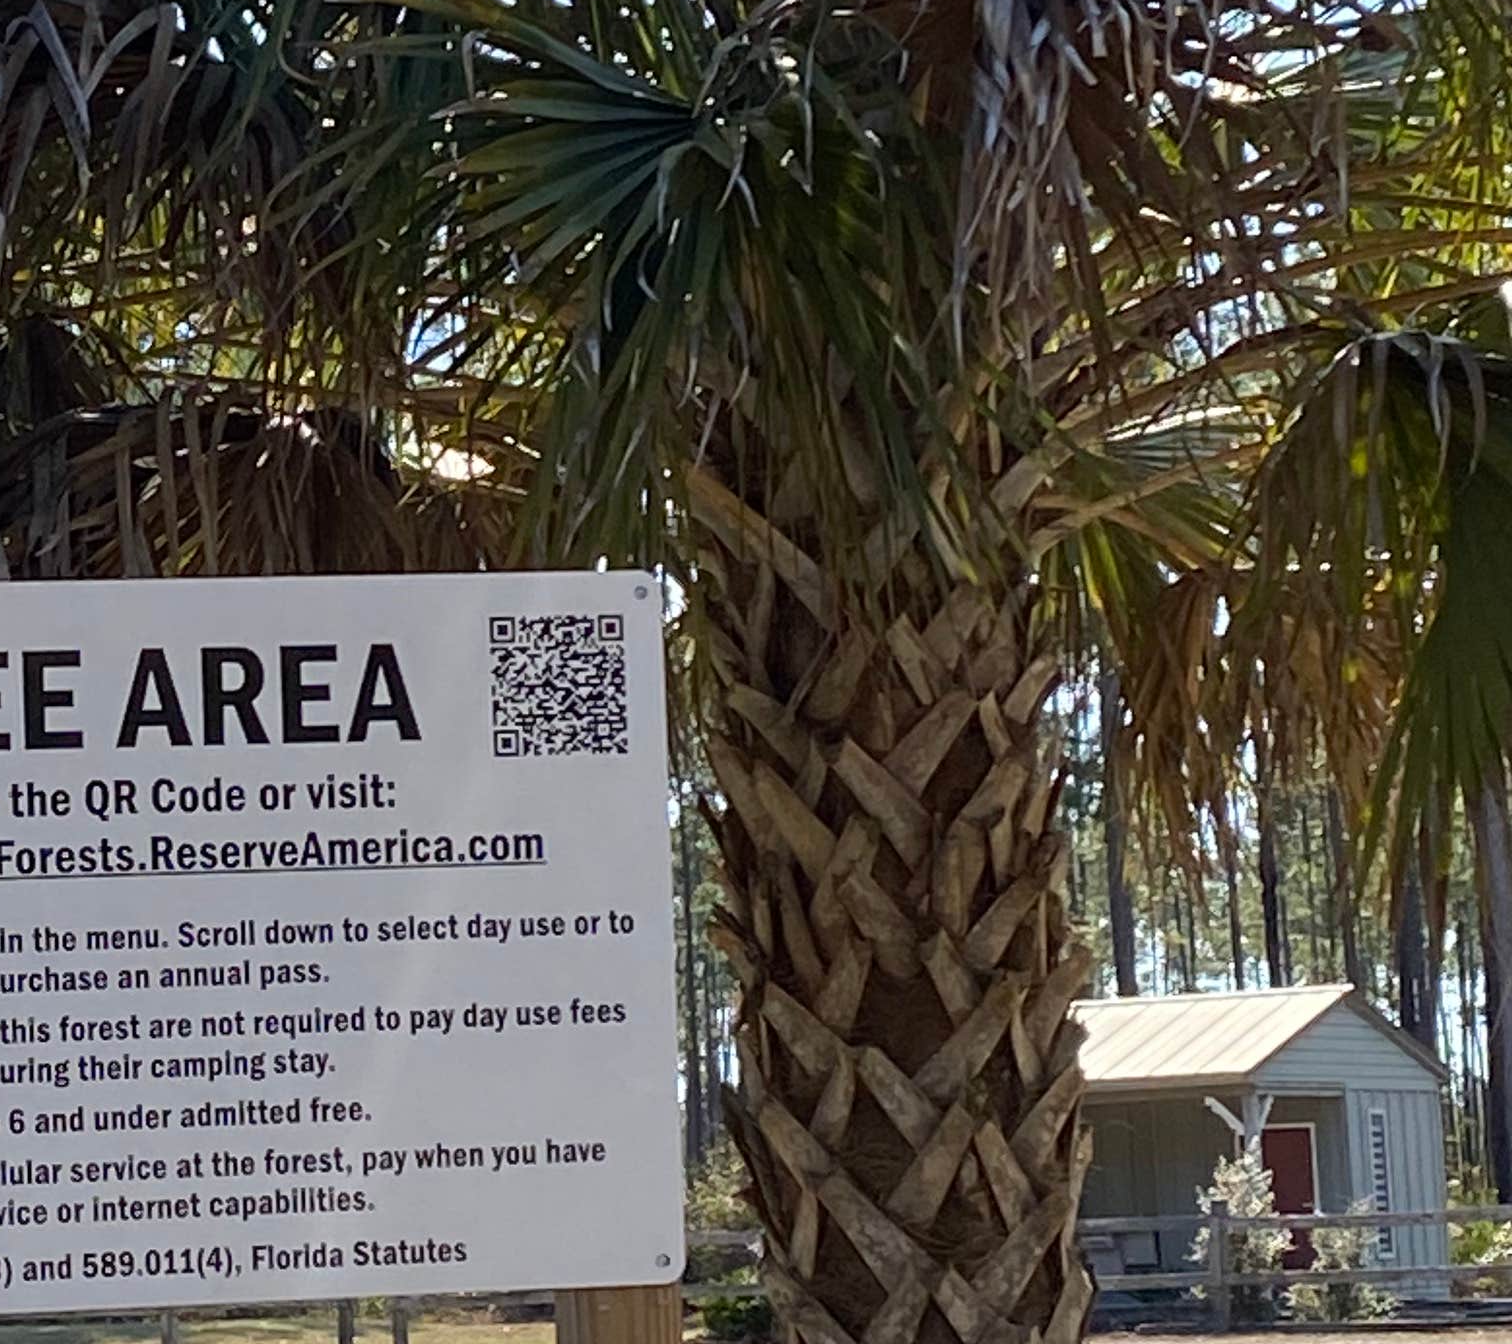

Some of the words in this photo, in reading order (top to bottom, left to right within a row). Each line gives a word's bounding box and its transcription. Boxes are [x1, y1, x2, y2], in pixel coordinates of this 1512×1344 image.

[115, 643, 423, 749] AREA
[8, 781, 72, 818] the
[84, 779, 139, 822] QR
[151, 776, 246, 814] Code
[259, 783, 297, 811] or
[306, 773, 396, 810] visit:
[0, 927, 23, 954] in
[31, 925, 77, 954] the
[85, 928, 169, 951] menu.
[177, 919, 256, 948] Scroll
[264, 918, 334, 945] down
[342, 917, 369, 943] to
[377, 914, 460, 942] select
[466, 913, 512, 944] day
[519, 916, 566, 937] use
[574, 915, 601, 936] or
[608, 909, 634, 935] to
[117, 969, 151, 990] an
[159, 959, 250, 989] annual
[259, 963, 330, 991] pass.
[58, 1014, 141, 1043] forest
[148, 1017, 192, 1040] are
[201, 1010, 246, 1038] not
[253, 1005, 366, 1041] required
[373, 1005, 401, 1032] to
[409, 1008, 456, 1036] pay
[462, 1002, 508, 1033] day
[516, 1005, 561, 1026] use
[569, 997, 627, 1025] fees
[77, 1053, 143, 1082] their
[150, 1049, 267, 1083] camping
[273, 1048, 336, 1079] stay.
[8, 1108, 26, 1135] 6
[34, 1105, 85, 1135] and
[93, 1103, 173, 1132] under
[180, 1097, 301, 1129] admitted
[309, 1096, 372, 1123] free.
[69, 1154, 167, 1183] service
[176, 1152, 205, 1179] at
[211, 1150, 256, 1178] the
[263, 1146, 353, 1176] forest,
[362, 1150, 407, 1177] pay
[414, 1142, 484, 1169] when
[491, 1144, 537, 1172] you
[545, 1138, 606, 1164] have
[56, 1202, 85, 1224] or
[92, 1192, 202, 1222] internet
[209, 1186, 375, 1222] capabilities.
[22, 1252, 73, 1282] and
[81, 1246, 242, 1280] 589.011(4),
[251, 1241, 344, 1271] Florida
[353, 1238, 467, 1267] Statutes
